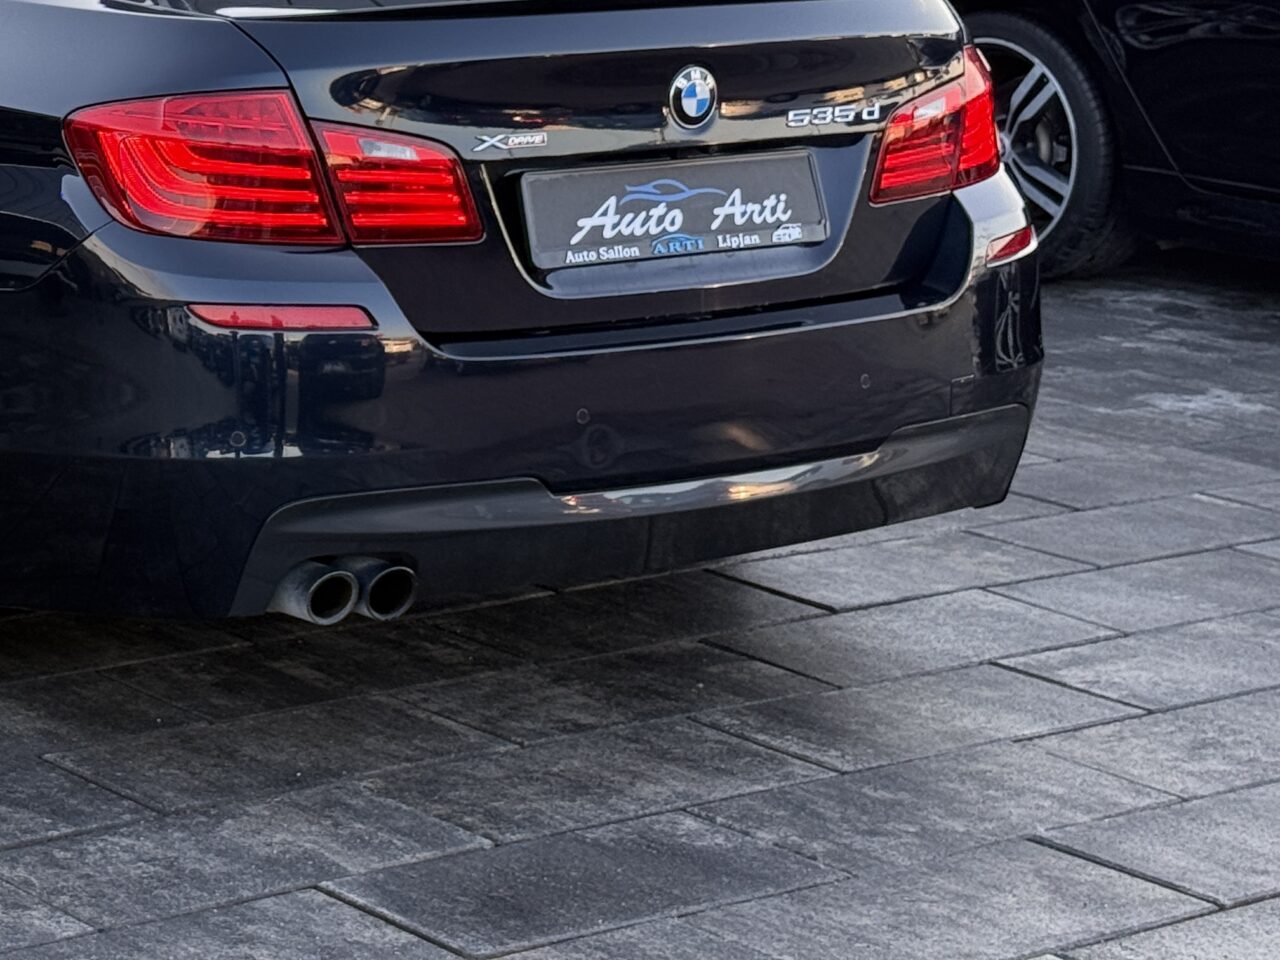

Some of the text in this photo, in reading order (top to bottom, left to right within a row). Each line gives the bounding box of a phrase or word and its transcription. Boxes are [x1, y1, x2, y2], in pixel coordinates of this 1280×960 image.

[675, 70, 715, 90] BMW
[570, 188, 793, 246] Auto Arti
[653, 238, 705, 255] ARTI
[716, 232, 762, 249] Lipjan
[565, 244, 641, 264] Auto Sallon
